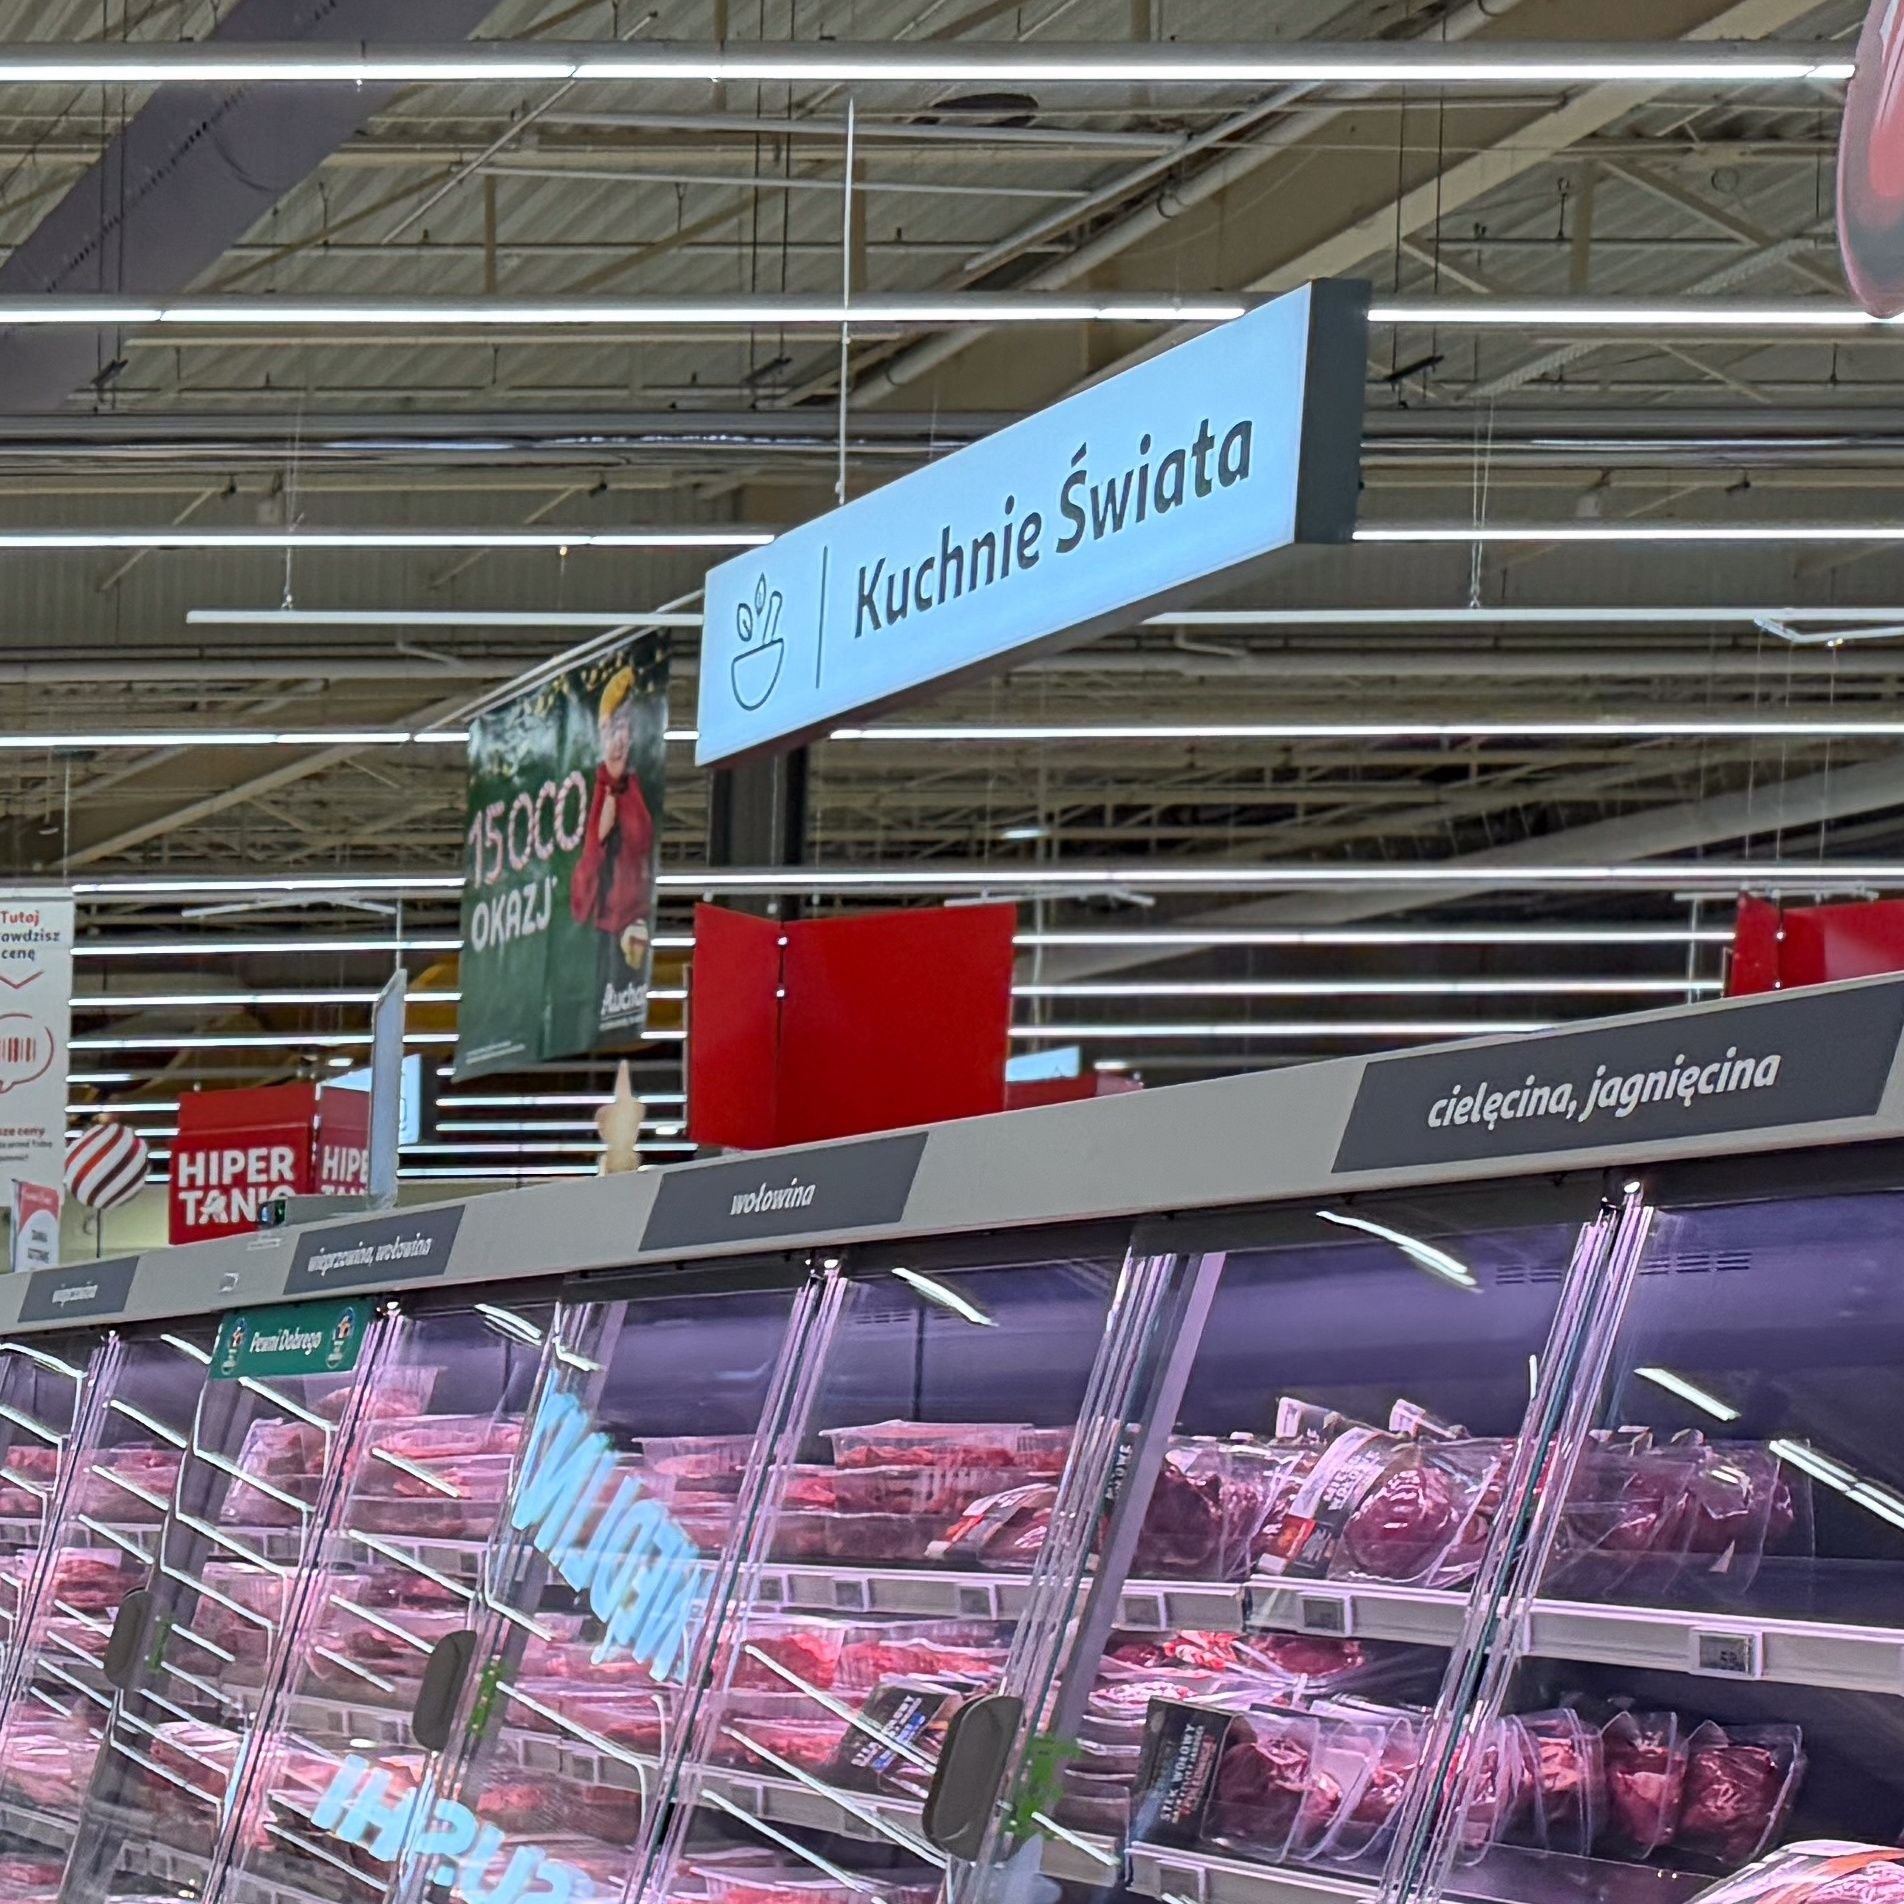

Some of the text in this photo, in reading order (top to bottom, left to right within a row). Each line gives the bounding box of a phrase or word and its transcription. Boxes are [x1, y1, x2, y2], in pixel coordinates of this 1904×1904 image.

[854, 417, 1254, 640] Kuchnie Świata
[0, 910, 40, 927] Tutaj
[1, 949, 35, 961] cenę
[1427, 1046, 1782, 1131] cielęcina, jagnięcina
[17, 1127, 45, 1138] ceny
[178, 1146, 295, 1188] HIPER
[322, 1144, 369, 1184] HIPE
[729, 1177, 816, 1216] wołowina
